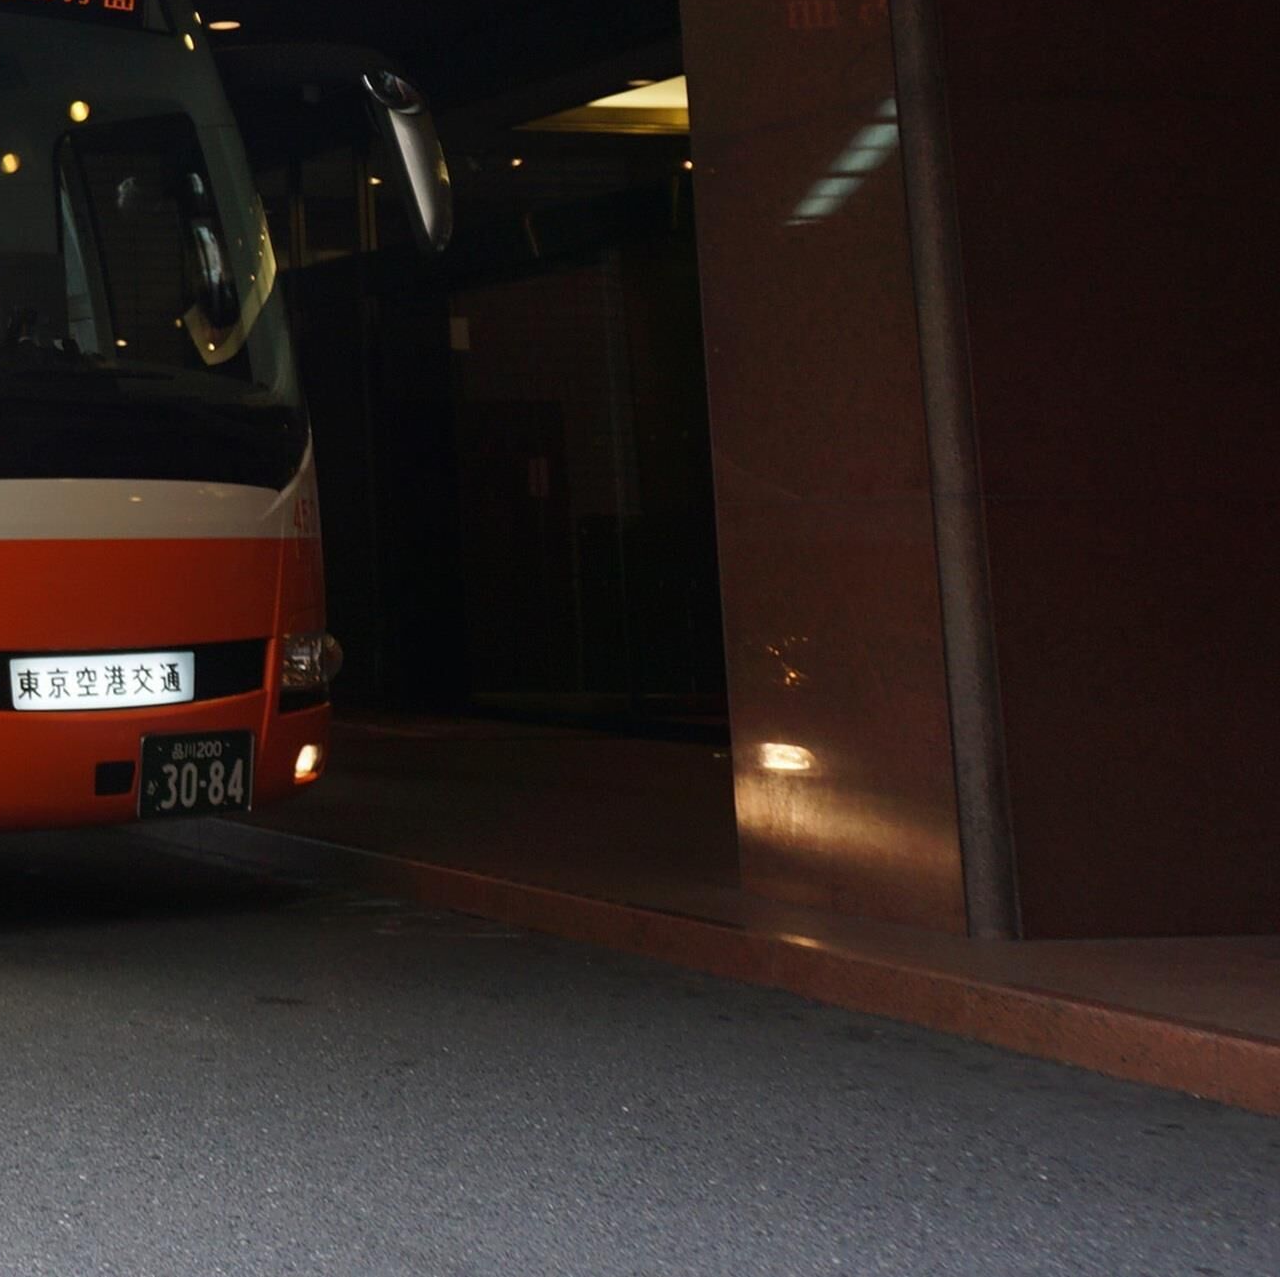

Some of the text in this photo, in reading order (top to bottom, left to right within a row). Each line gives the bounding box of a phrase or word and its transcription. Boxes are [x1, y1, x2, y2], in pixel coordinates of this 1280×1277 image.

[17, 663, 182, 700] 東京空港交通
